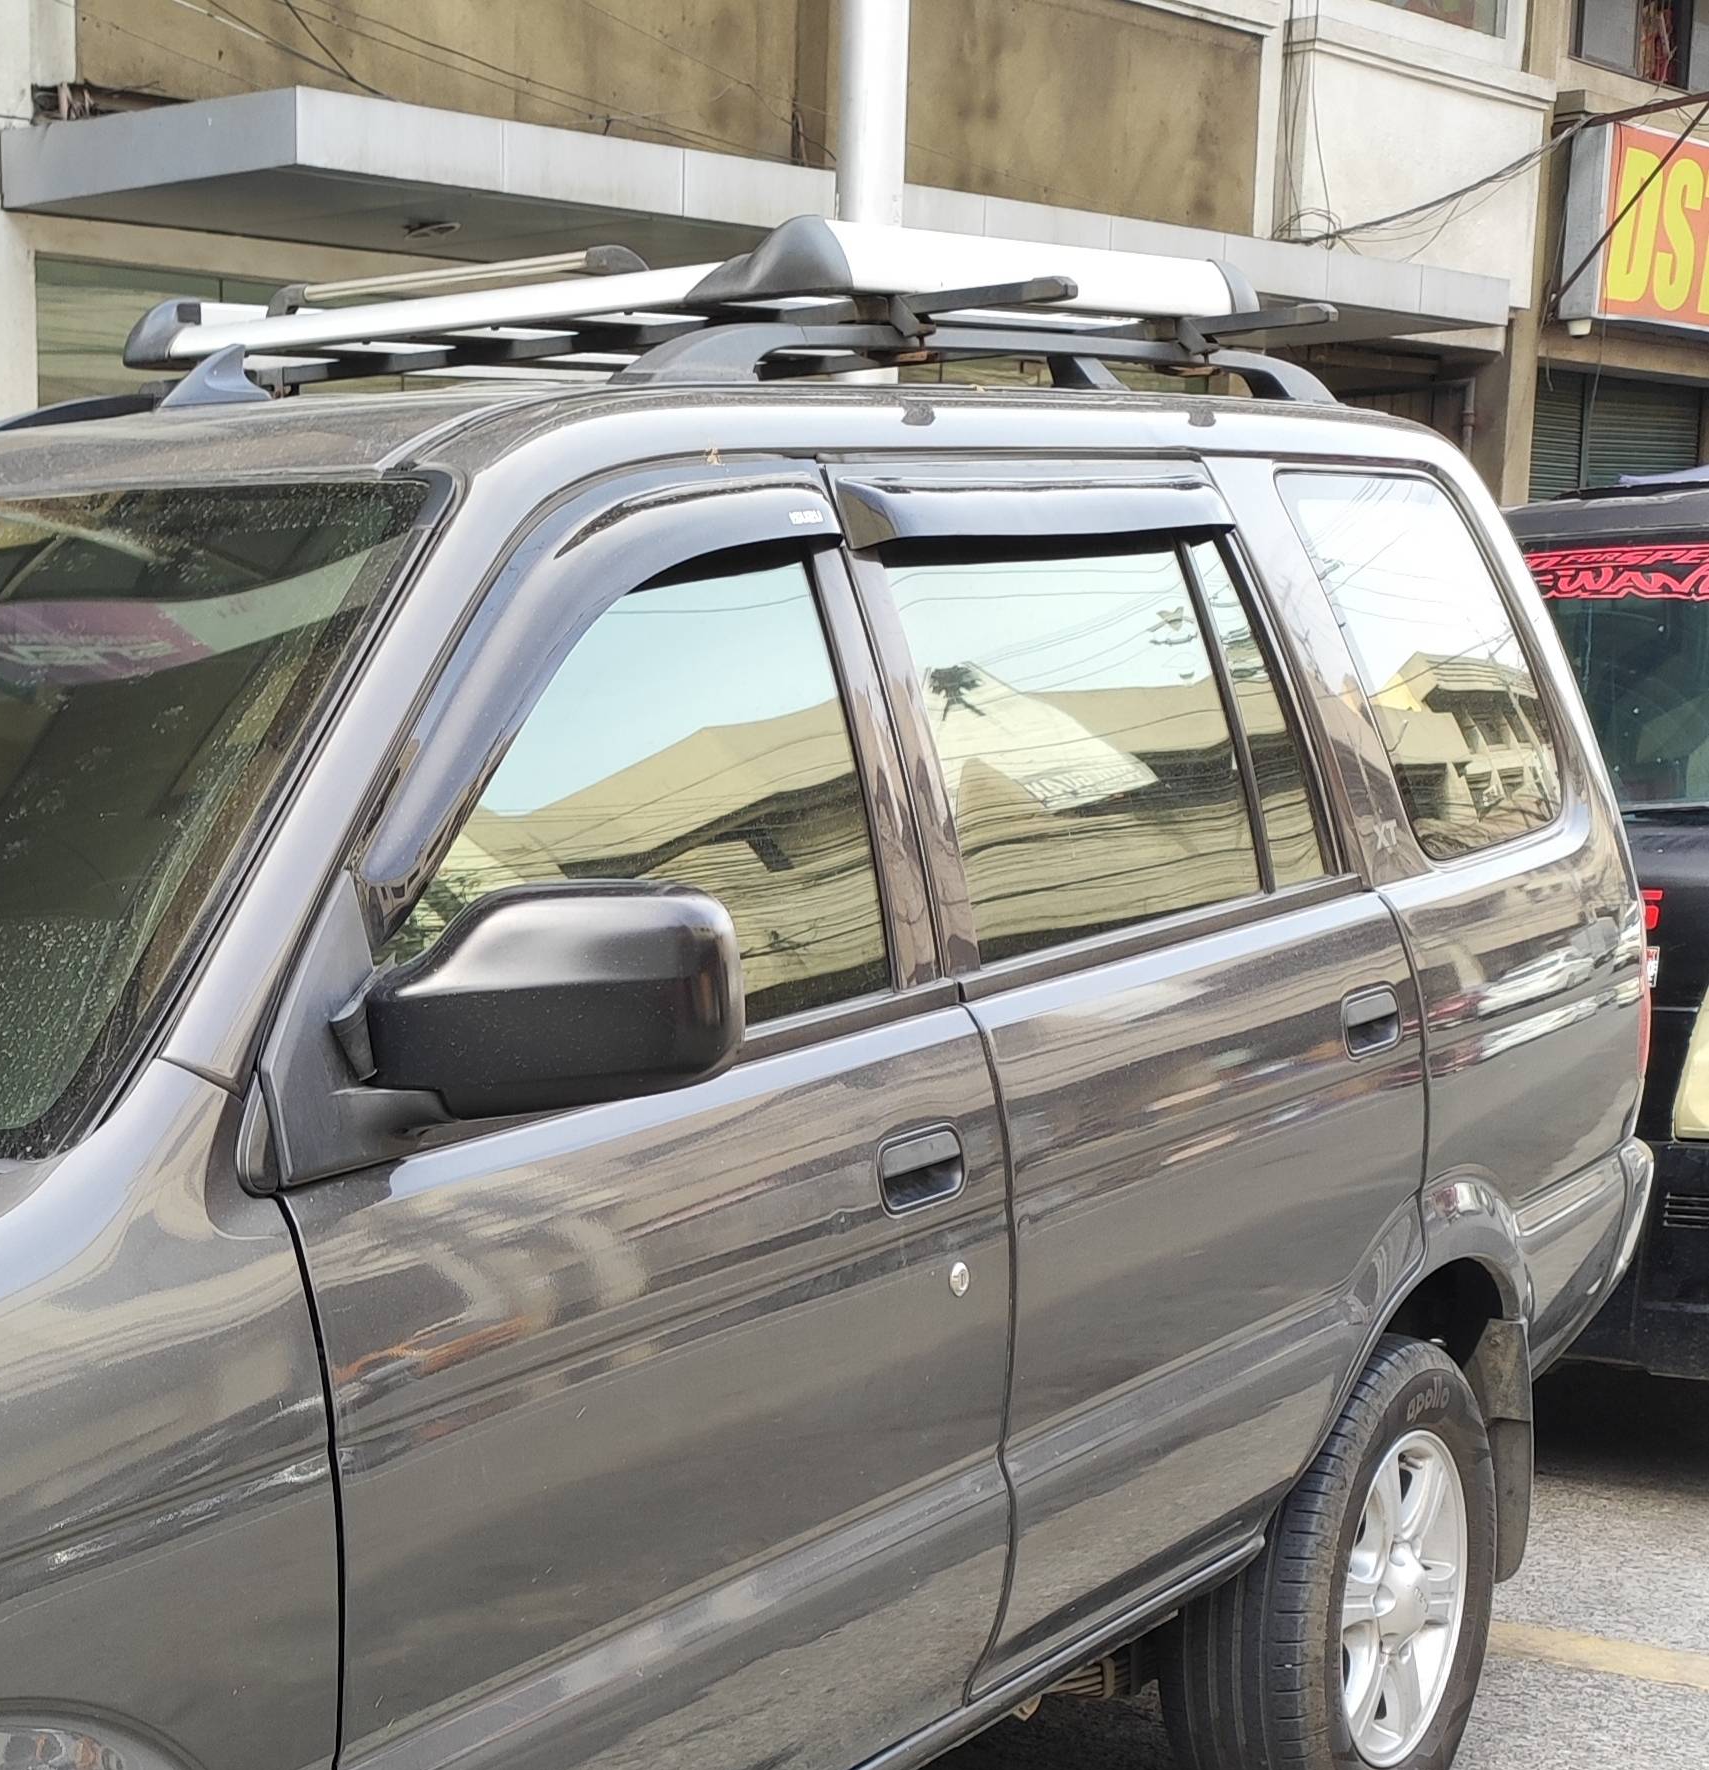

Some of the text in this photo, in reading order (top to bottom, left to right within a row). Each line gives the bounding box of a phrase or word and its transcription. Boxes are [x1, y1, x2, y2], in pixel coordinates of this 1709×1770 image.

[1604, 147, 1709, 315] DS
[1615, 549, 1709, 566] SPE
[1405, 1375, 1450, 1425] apollo
